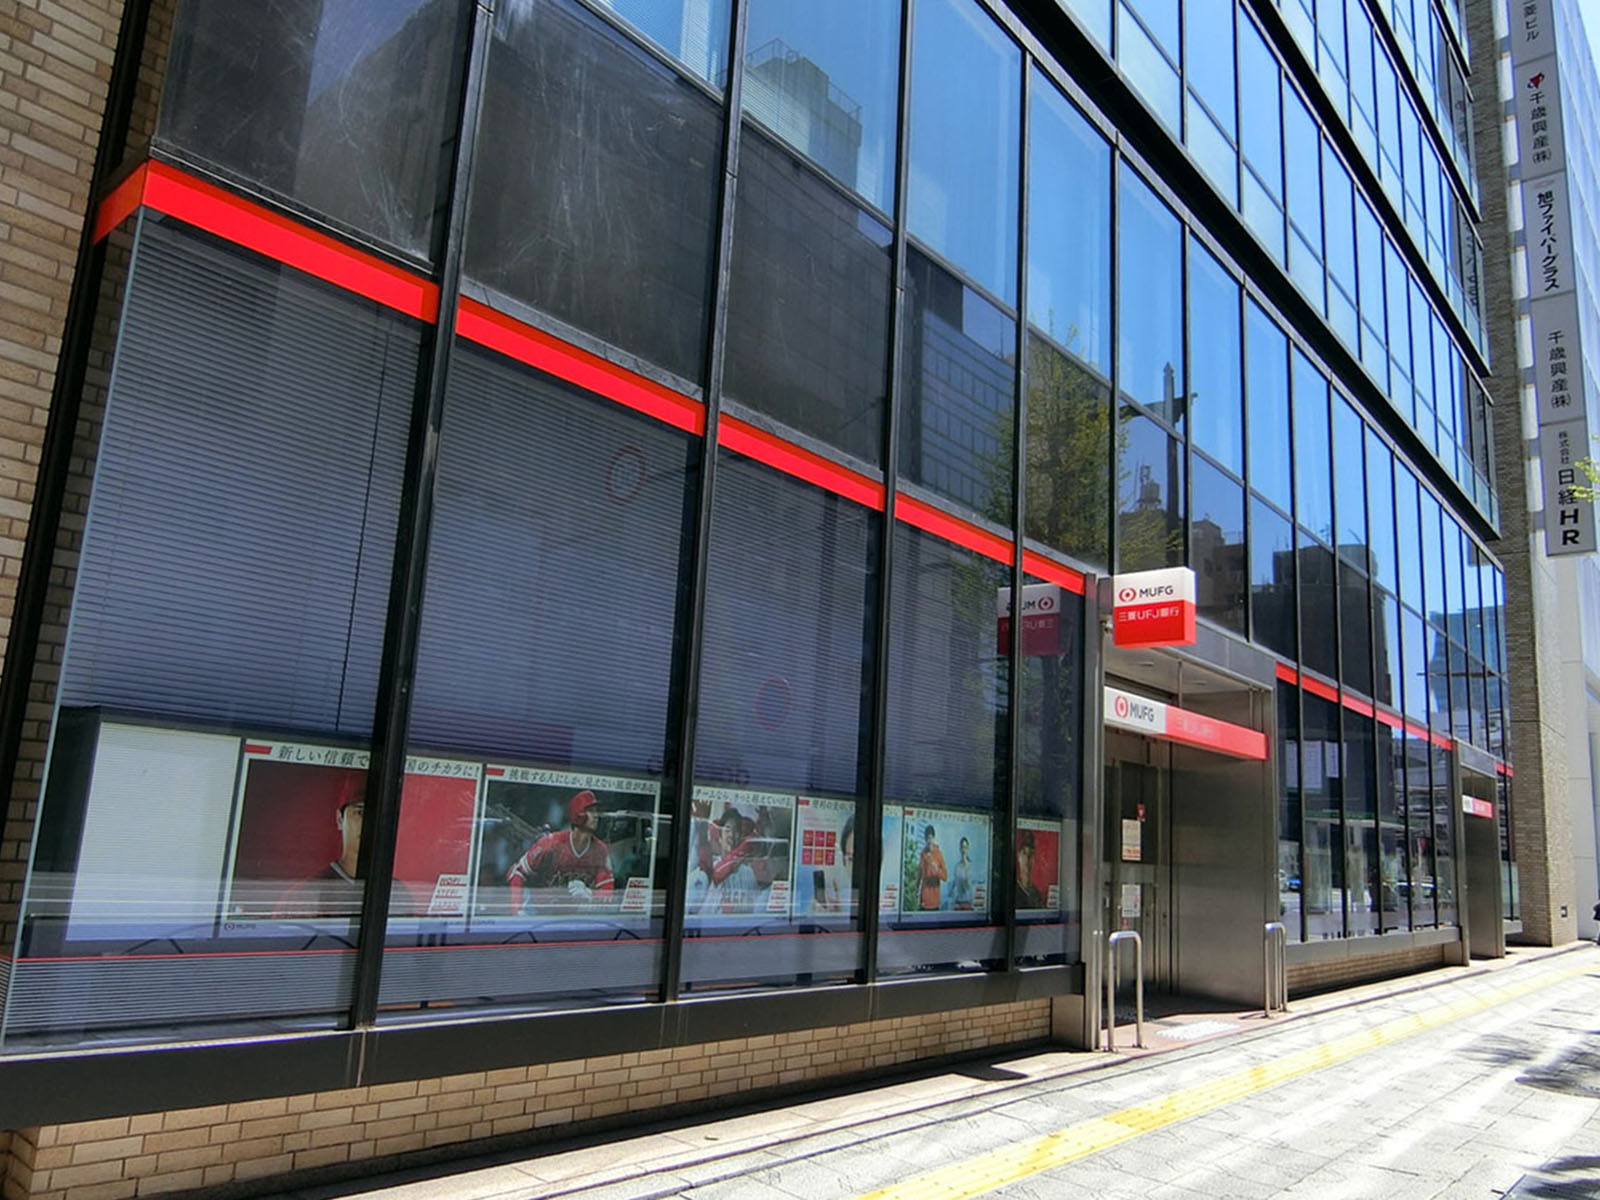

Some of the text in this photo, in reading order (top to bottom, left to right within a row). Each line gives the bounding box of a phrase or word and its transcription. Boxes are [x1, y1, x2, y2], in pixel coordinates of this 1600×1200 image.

[1537, 191, 1560, 291] 旭ファイバーグラス
[1139, 585, 1174, 598] MUFG
[1130, 701, 1154, 722] MUFG
